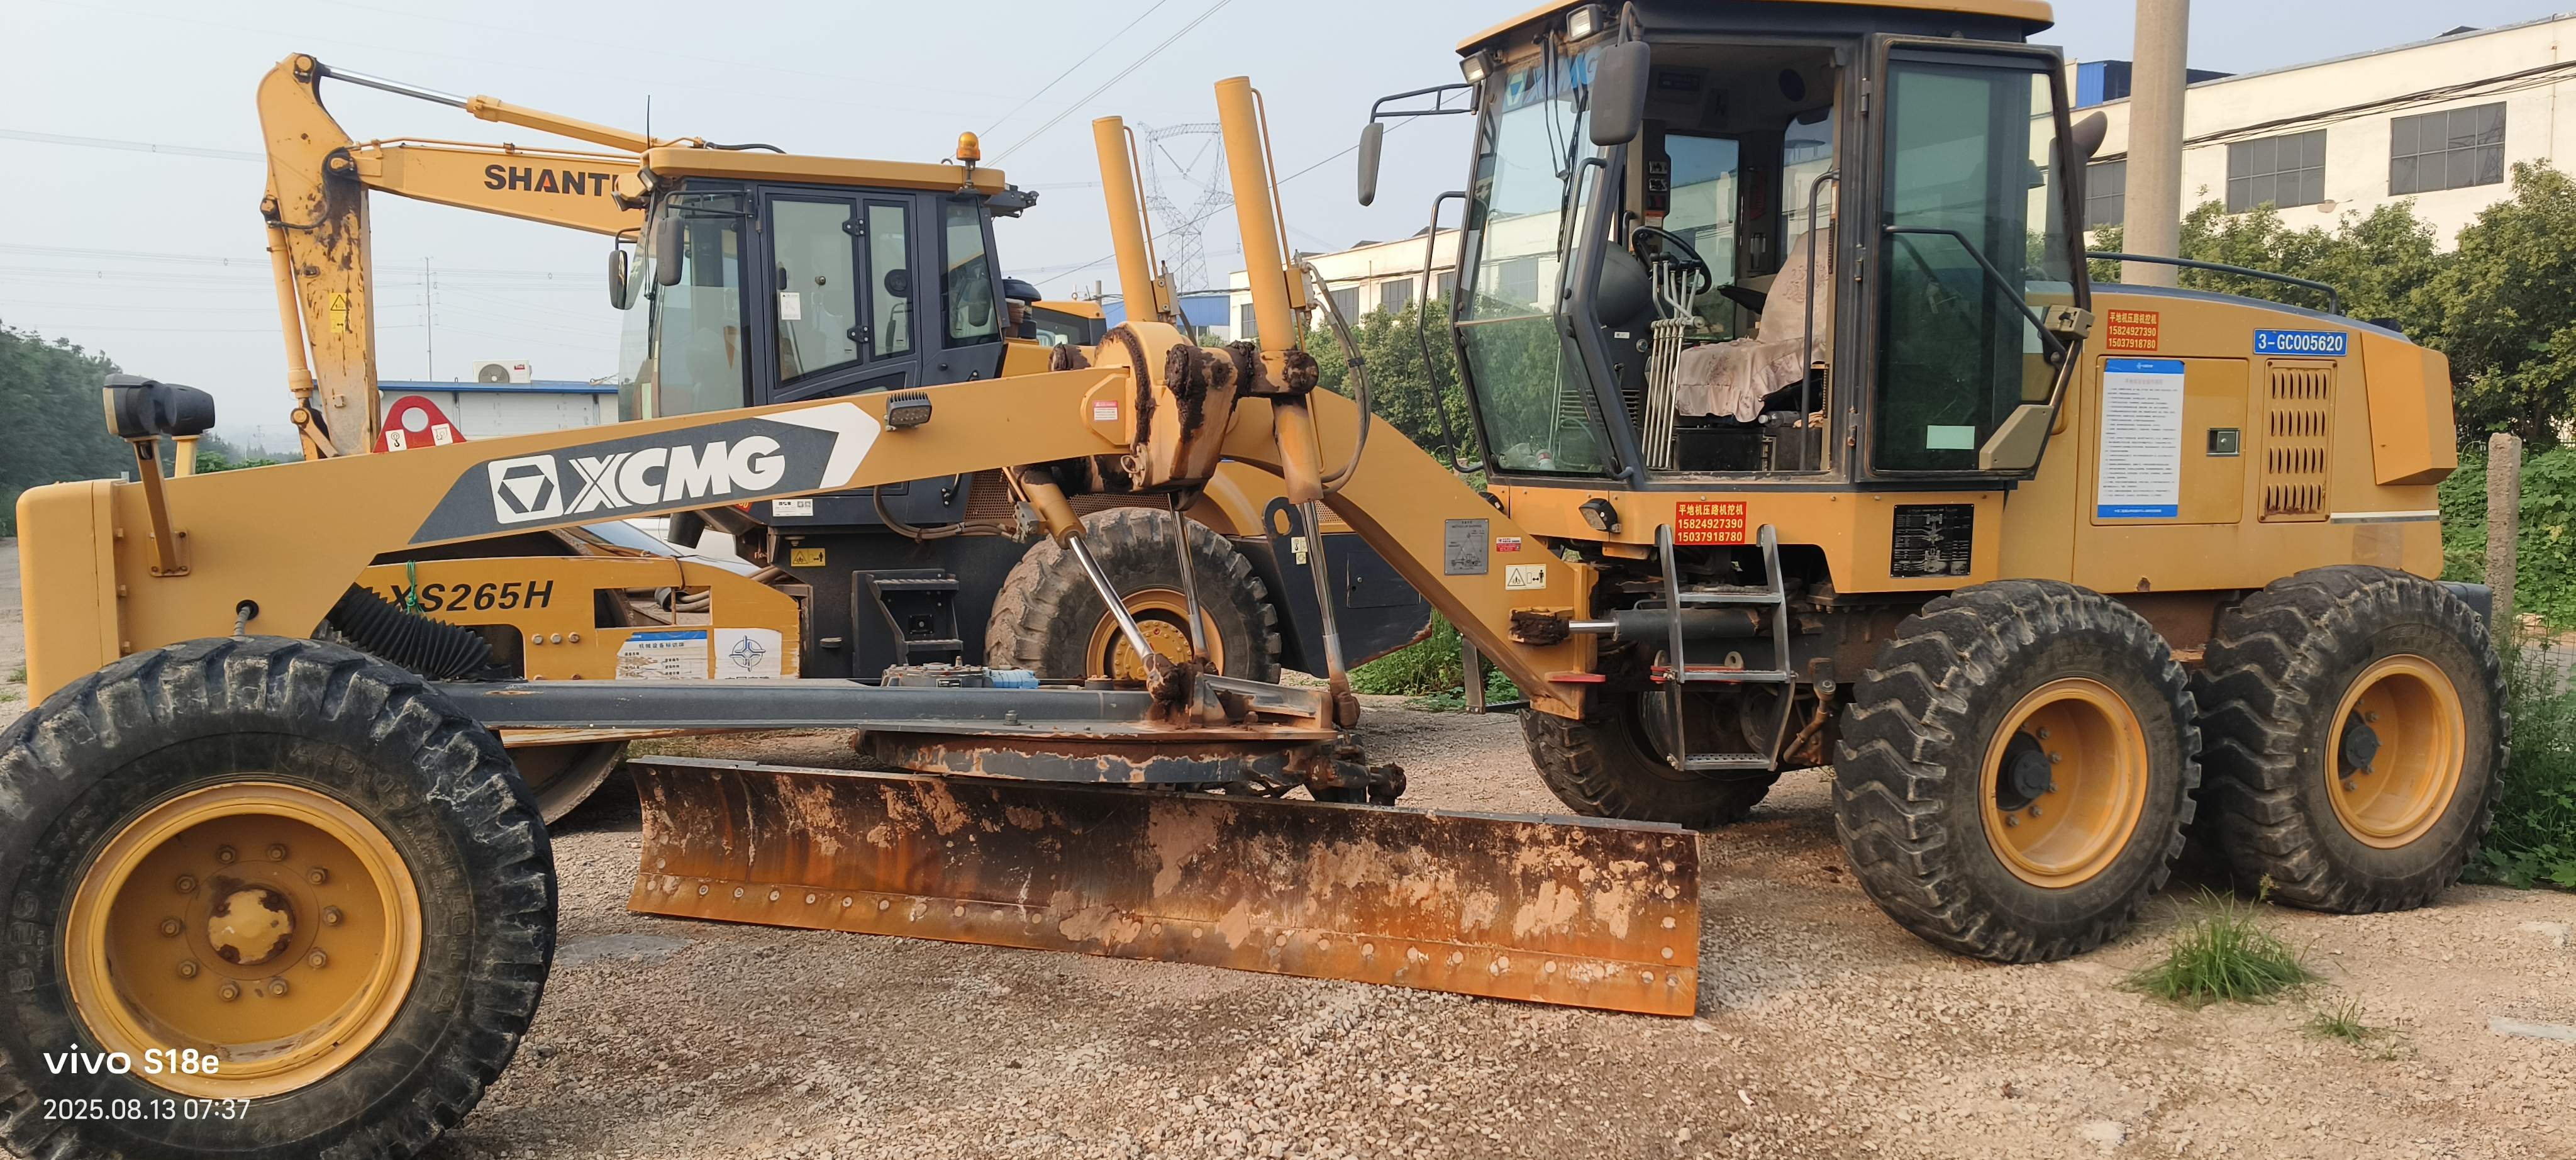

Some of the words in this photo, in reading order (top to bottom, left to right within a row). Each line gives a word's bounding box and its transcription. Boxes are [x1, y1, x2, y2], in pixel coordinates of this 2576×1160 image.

[2110, 312, 2157, 324] 平地机压路机挖机
[2109, 325, 2156, 337] 15824927390
[2109, 338, 2156, 349] 15037918780
[2258, 333, 2343, 351] 3-GC005620
[564, 435, 786, 515] XCMG
[1679, 504, 1743, 516] 平地机压路机挖机
[1678, 518, 1743, 529] 15824927390
[1677, 532, 1742, 542] 15037918780
[391, 580, 553, 613] XS265H
